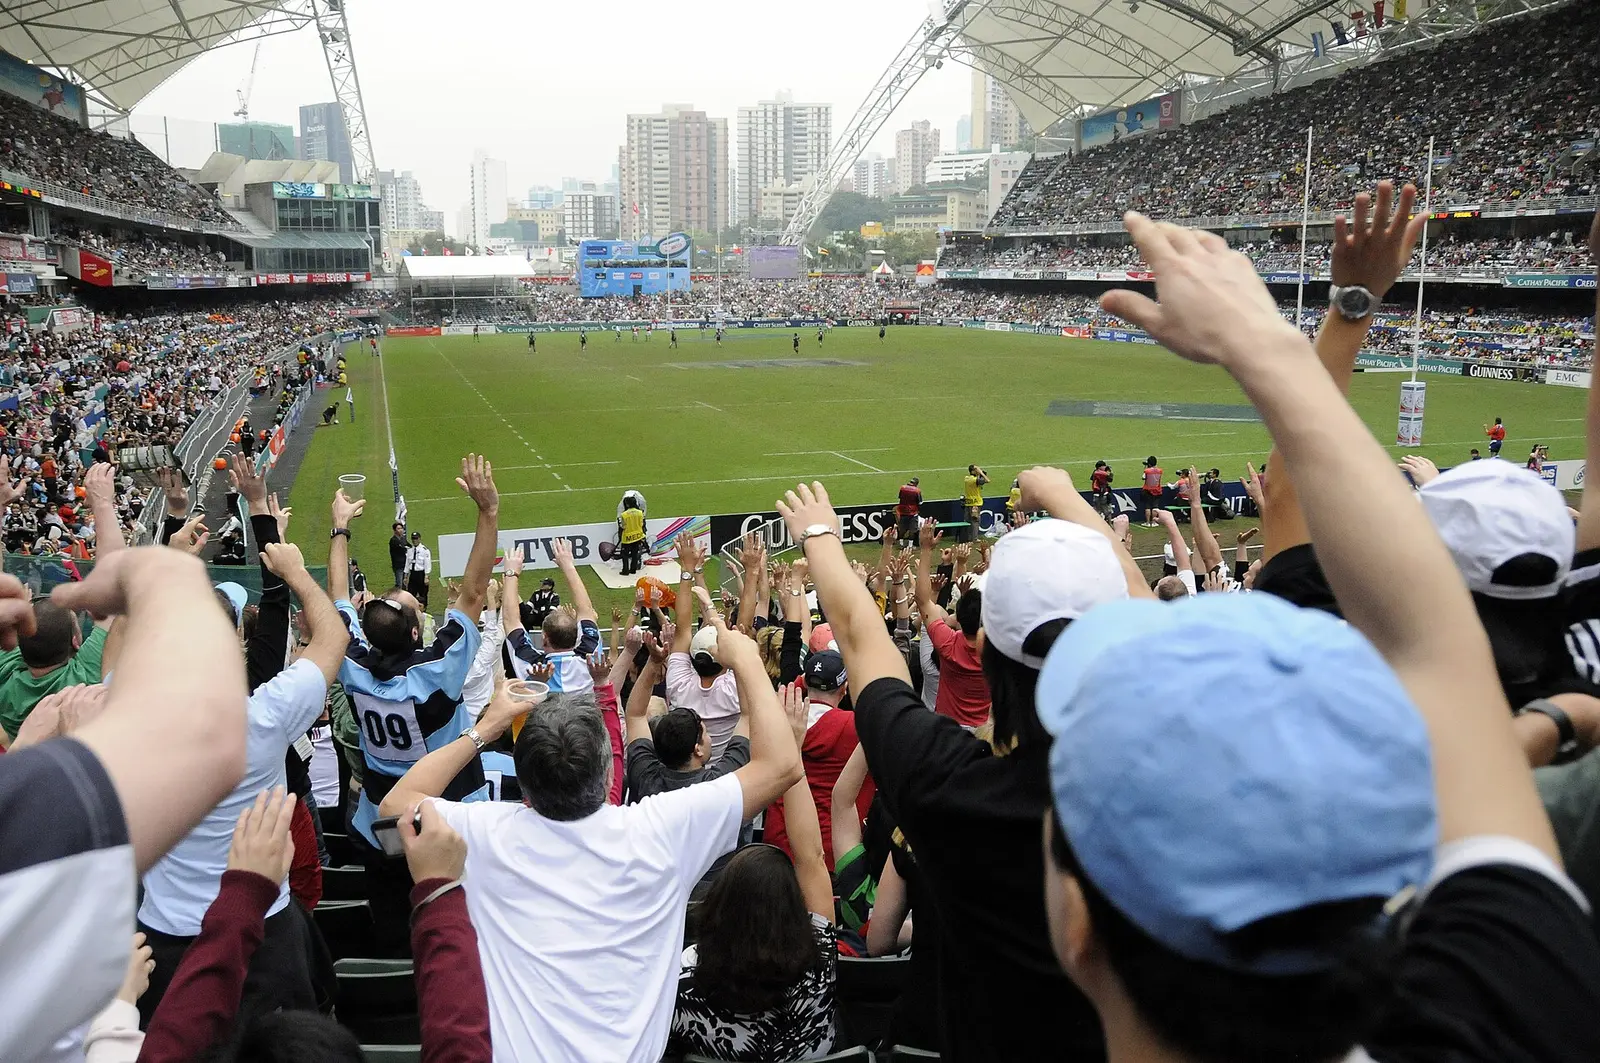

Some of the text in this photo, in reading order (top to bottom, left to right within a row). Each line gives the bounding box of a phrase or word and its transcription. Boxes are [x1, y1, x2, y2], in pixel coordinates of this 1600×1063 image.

[326, 273, 347, 283] SEVENS
[1517, 278, 1569, 287] CATHAY PACIFIC
[1575, 278, 1598, 288] CREDI
[847, 319, 875, 327] GUINNESS
[1355, 357, 1399, 369] CATHAY PACIFIC
[1416, 363, 1462, 375] ATHAY PACIFIC
[1469, 364, 1514, 380] GUINNESS
[741, 511, 884, 548] GUESS
[514, 535, 590, 564] TVB
[364, 709, 412, 750] 09
